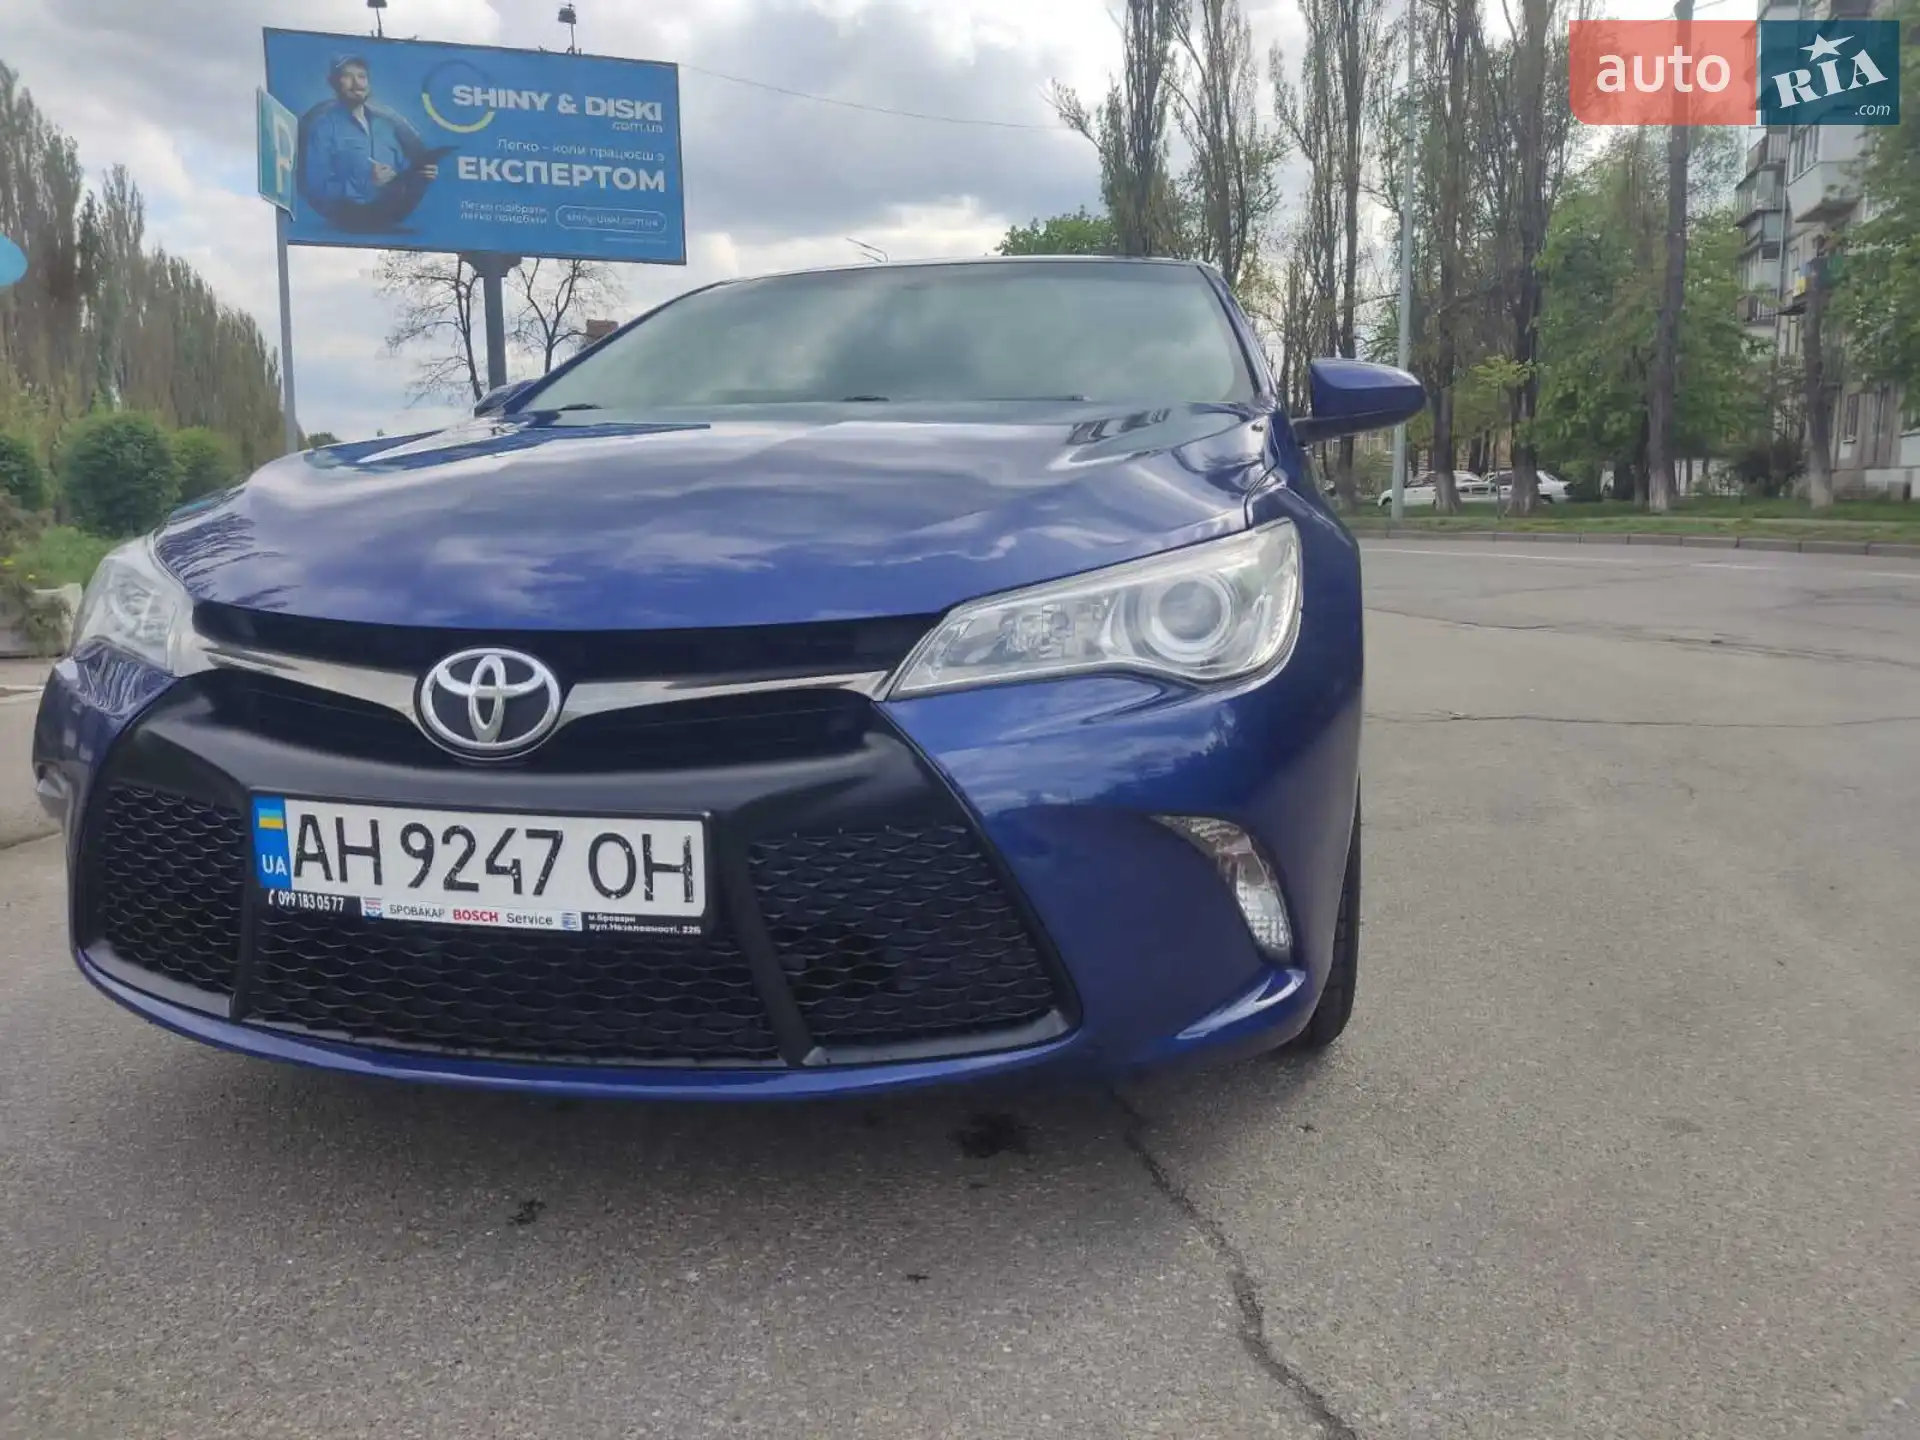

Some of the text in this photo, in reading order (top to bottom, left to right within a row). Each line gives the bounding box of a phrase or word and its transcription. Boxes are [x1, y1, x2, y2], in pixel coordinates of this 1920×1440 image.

[452, 84, 663, 121] SHINY & DISKI
[457, 156, 665, 193] ЕКСПЕРТОМ
[262, 854, 288, 876] UA
[294, 814, 694, 902] AH 9247 OH
[453, 909, 499, 922] BOSCH
[507, 912, 553, 925] Service
